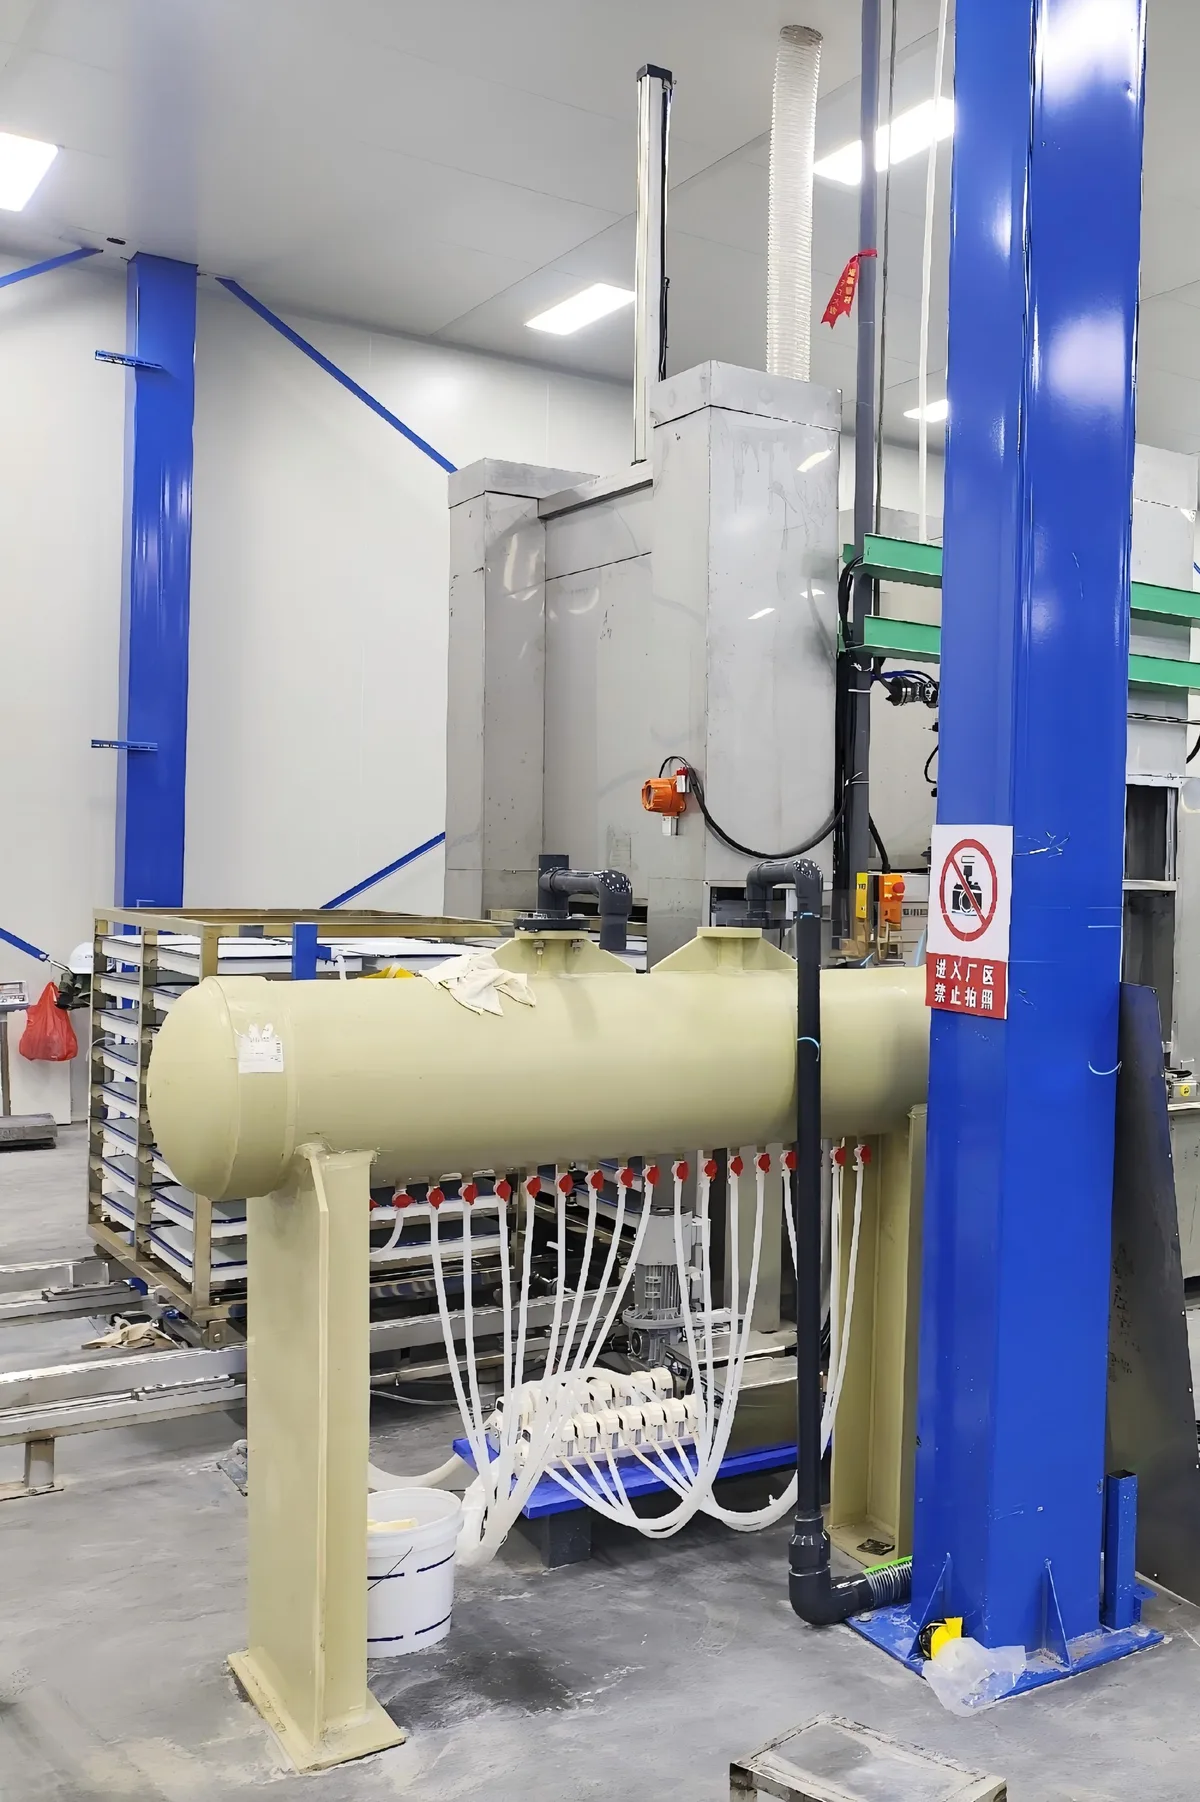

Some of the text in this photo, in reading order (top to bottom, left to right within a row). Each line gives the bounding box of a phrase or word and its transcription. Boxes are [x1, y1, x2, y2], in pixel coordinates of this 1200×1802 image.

[935, 959, 994, 986] 进入厂区
[934, 982, 993, 1010] 禁止拍照
